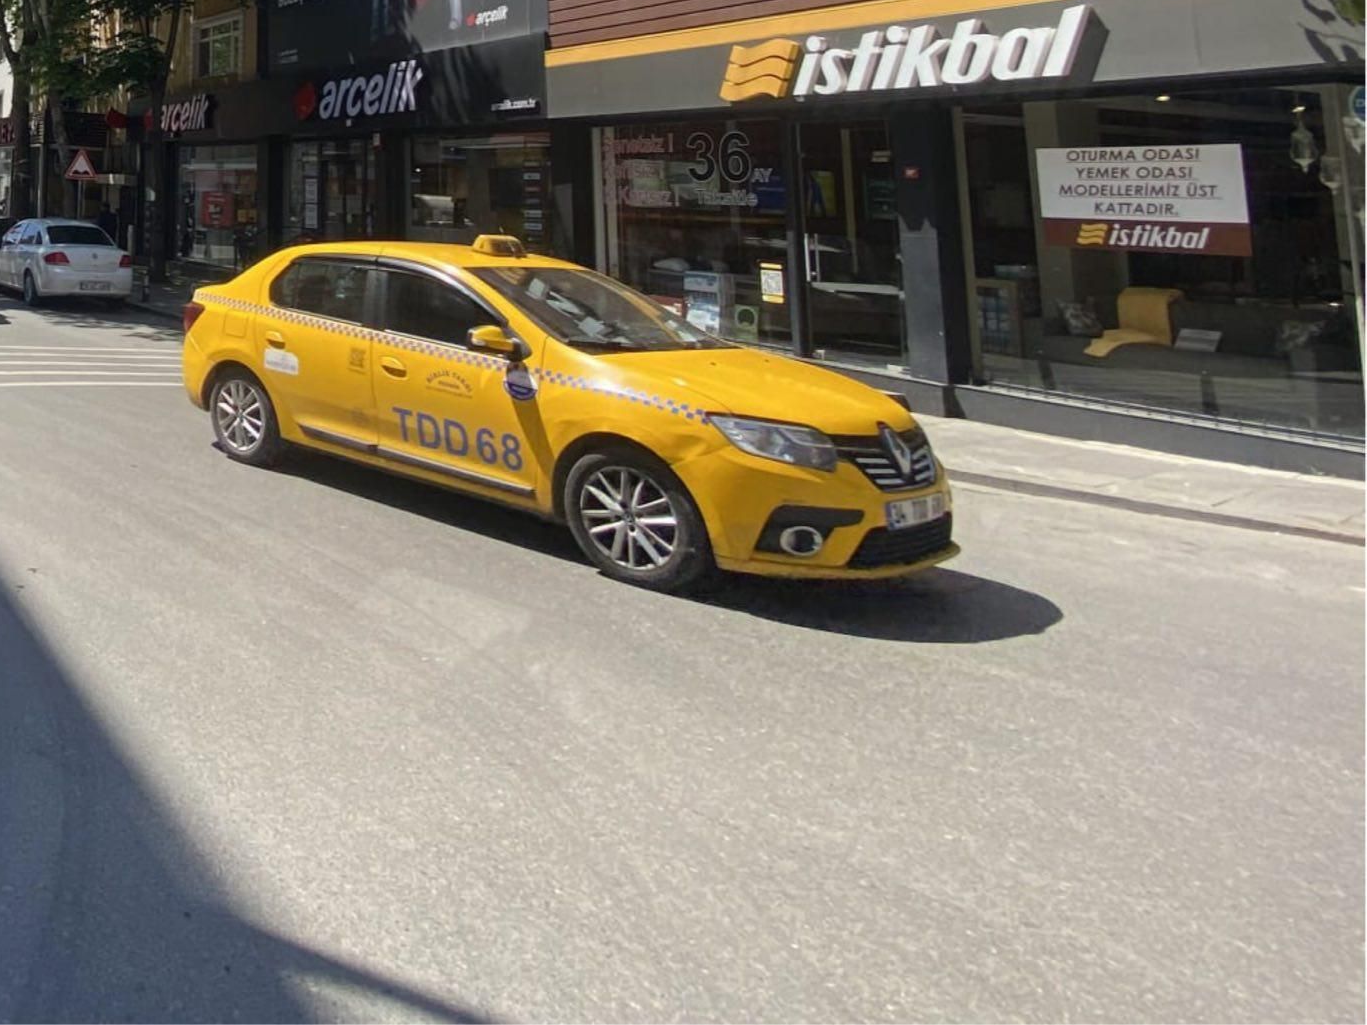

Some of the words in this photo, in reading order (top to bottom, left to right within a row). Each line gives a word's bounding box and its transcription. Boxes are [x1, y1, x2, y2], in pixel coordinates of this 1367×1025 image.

[793, 4, 1089, 96] istikbal
[686, 131, 752, 183] 36
[751, 168, 773, 182] AY
[1066, 150, 1136, 162] OTURMA
[1142, 148, 1200, 162] ODASI
[1076, 166, 1129, 179] YEMEK
[1136, 166, 1193, 179] ODASI
[1059, 182, 1179, 197] MODELLERİMİZ
[1186, 183, 1217, 197] ÜST
[1094, 202, 1179, 216] KATTADIR.
[1108, 223, 1210, 250] istikbal
[392, 406, 469, 456] TDD
[476, 428, 523, 471] 68
